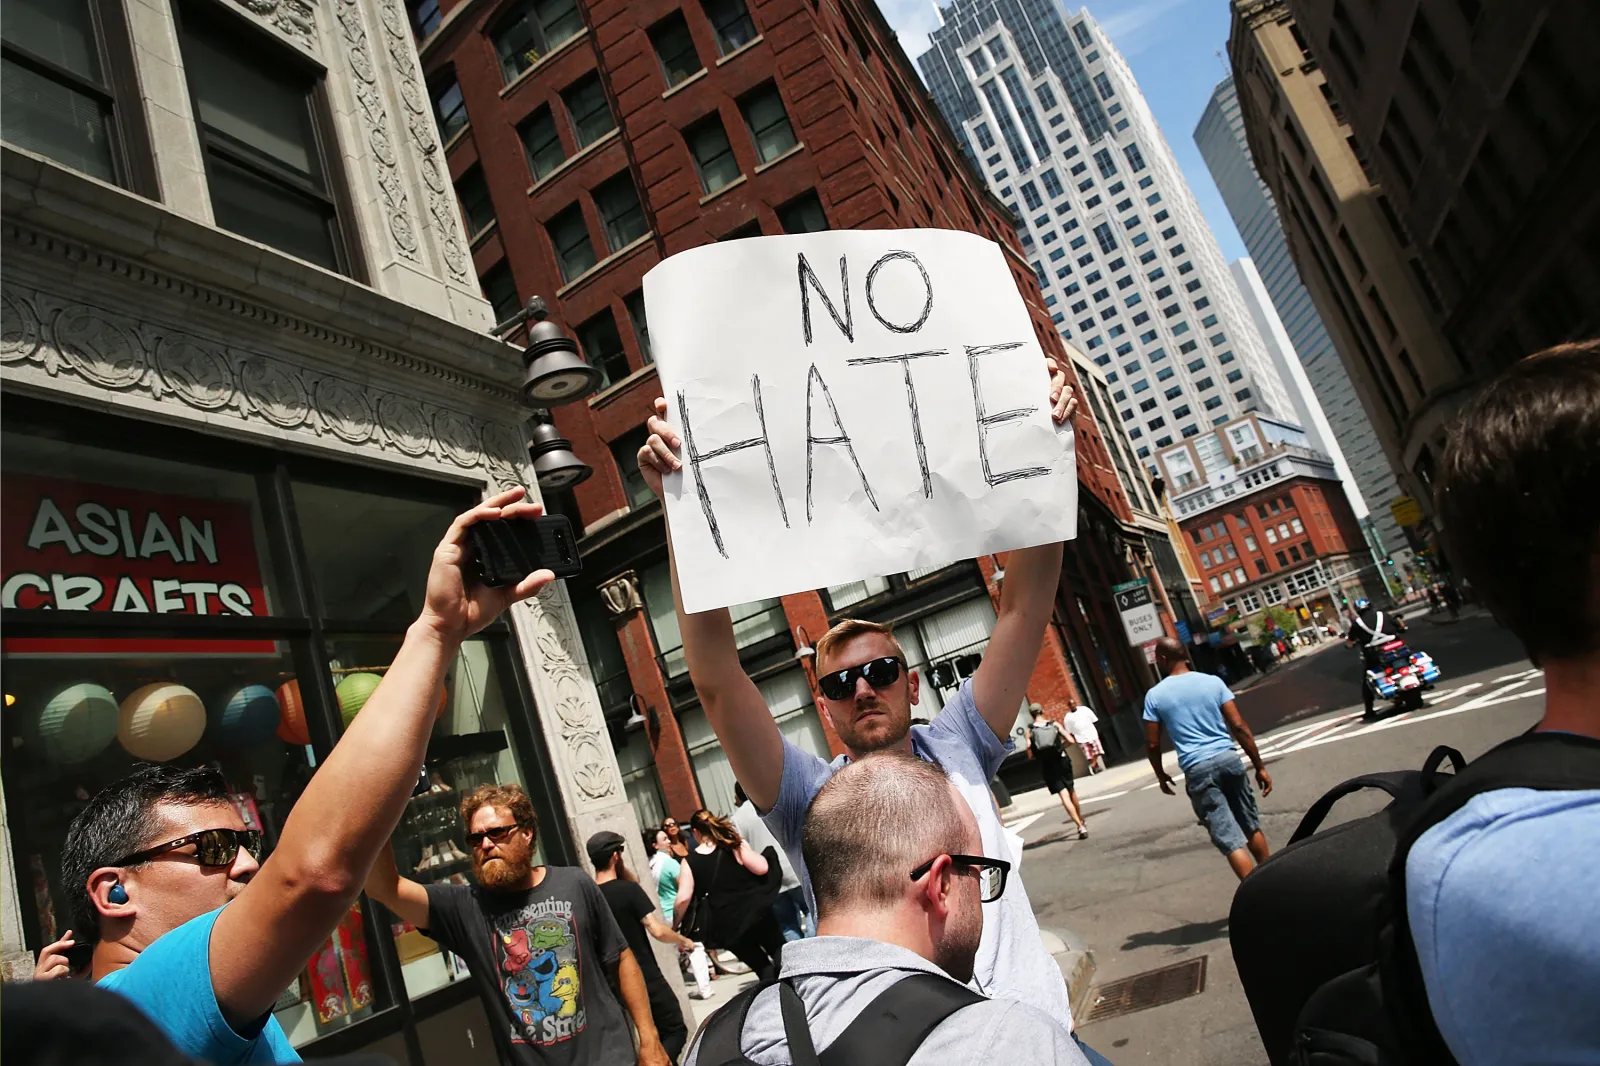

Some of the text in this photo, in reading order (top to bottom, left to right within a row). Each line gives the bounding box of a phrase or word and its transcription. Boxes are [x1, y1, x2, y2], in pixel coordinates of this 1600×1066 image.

[798, 249, 934, 347] NO
[676, 341, 1053, 560] HATE
[27, 498, 219, 565] ASIAN
[2, 573, 254, 616] CRAFTS
[1128, 614, 1153, 627] BUSES
[1133, 623, 1153, 634] ONLY
[495, 896, 572, 930] epresenting
[510, 1023, 537, 1041] te
